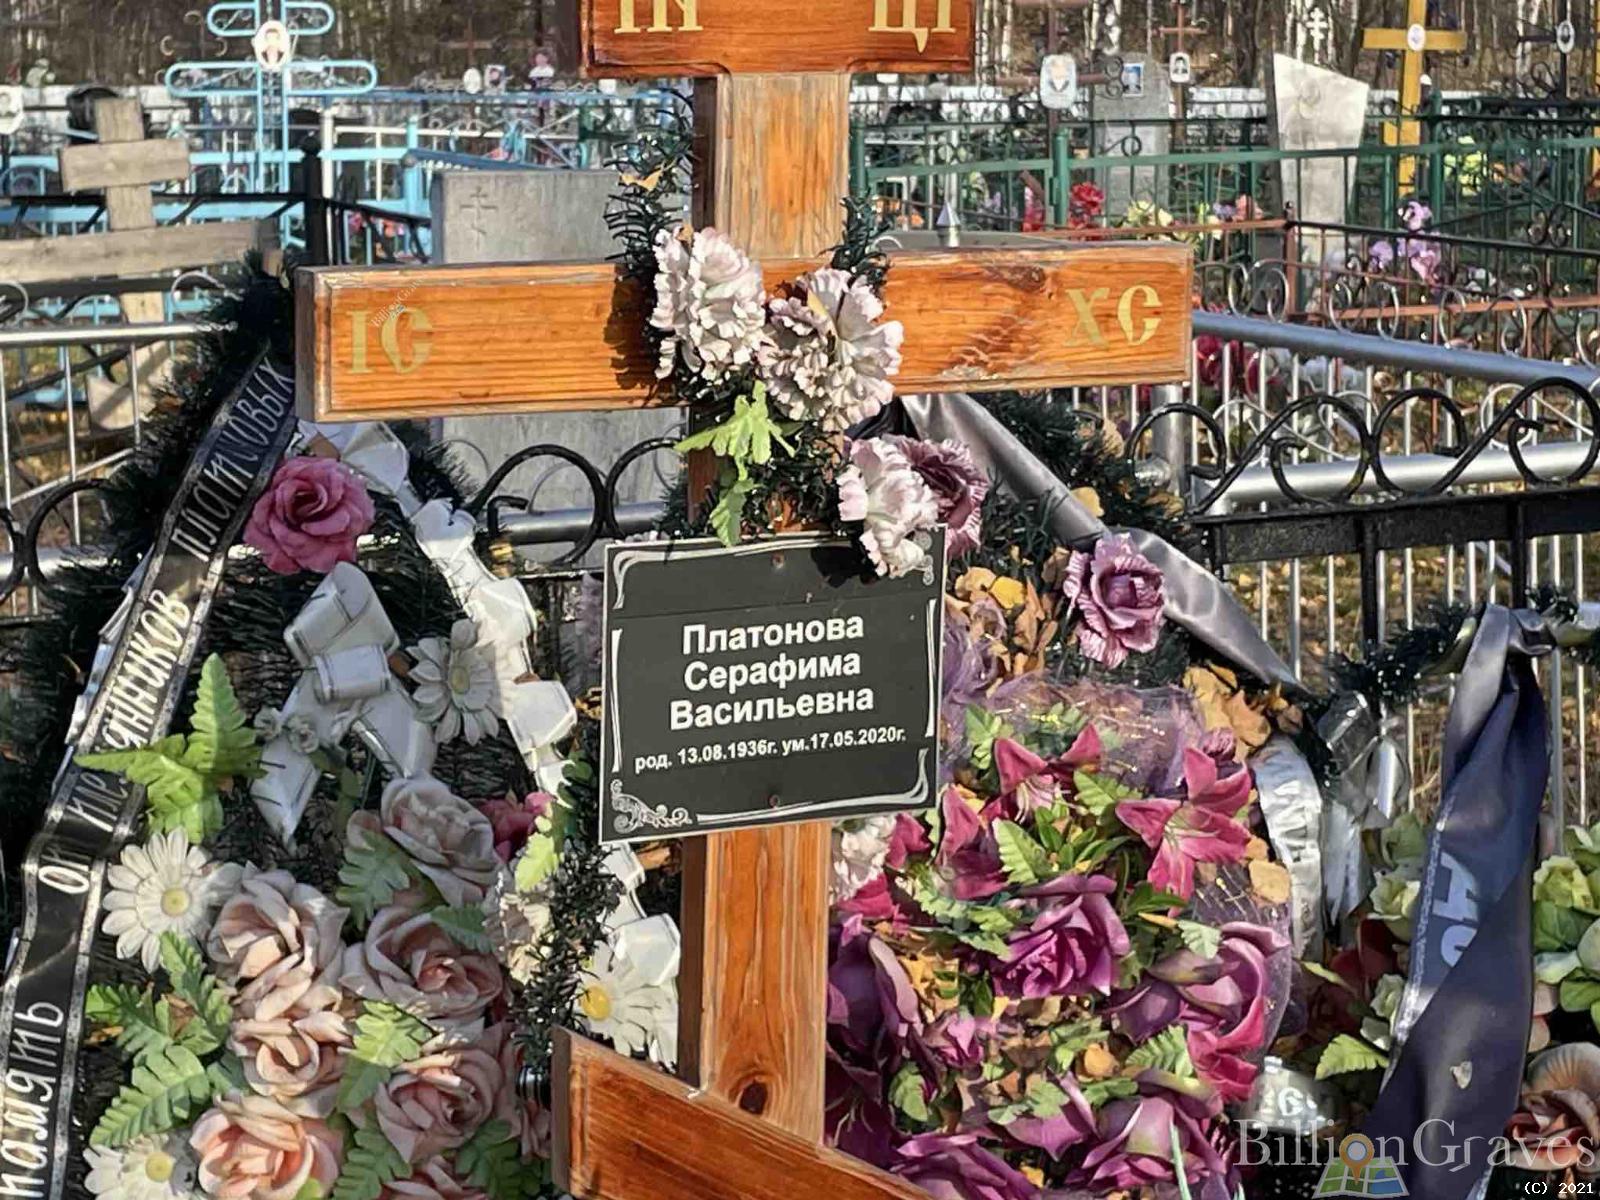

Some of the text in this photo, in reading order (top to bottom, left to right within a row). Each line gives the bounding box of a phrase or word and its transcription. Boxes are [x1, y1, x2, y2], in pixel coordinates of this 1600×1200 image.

[682, 615, 864, 655] Платонова
[684, 652, 861, 694] Серафима
[67, 589, 191, 833] плеянников
[669, 687, 874, 730] Васильевна
[634, 726, 906, 773] род. 13.08.1936г. ум.17.05.2020г.
